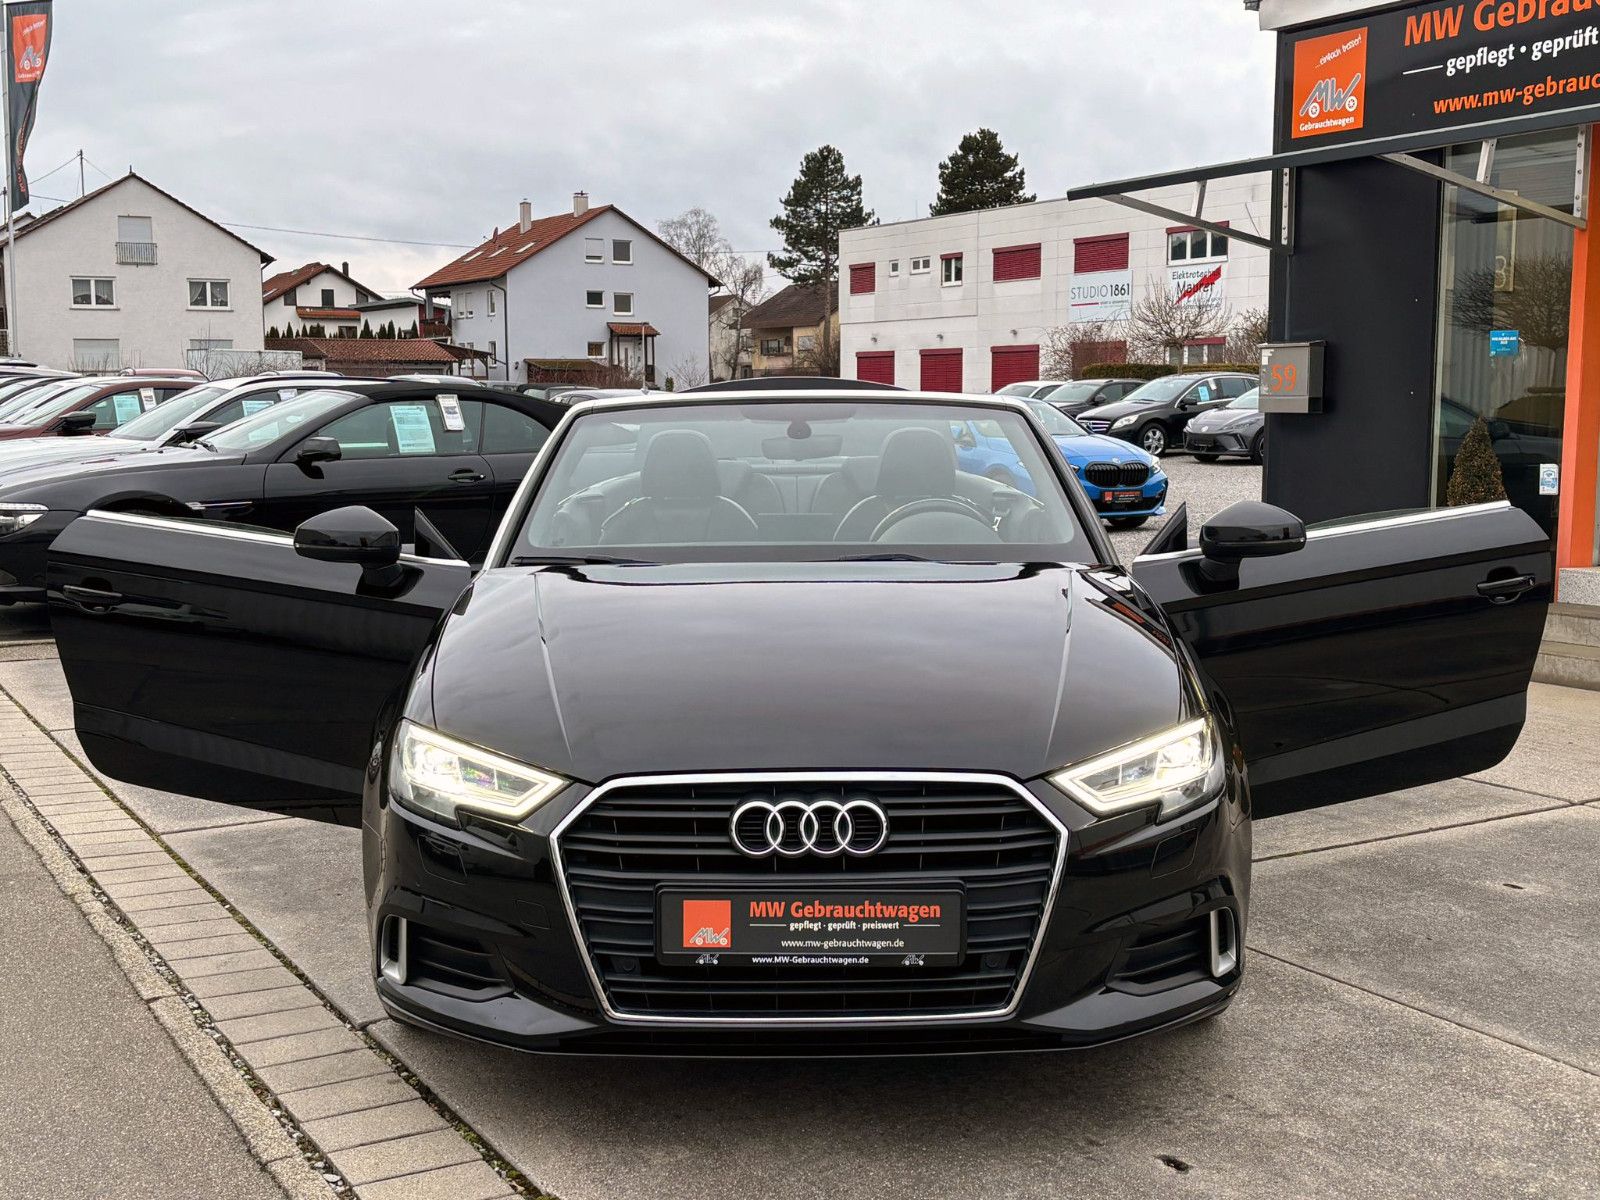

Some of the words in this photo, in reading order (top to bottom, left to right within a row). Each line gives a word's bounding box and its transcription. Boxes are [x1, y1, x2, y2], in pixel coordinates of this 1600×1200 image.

[1404, 4, 1464, 47] MW
[1446, 43, 1515, 77] gepflegt
[1531, 25, 1599, 61] geprüft
[1299, 116, 1355, 132] Gebrauchtwagen
[1271, 363, 1297, 392] 59
[749, 901, 786, 918] MW
[790, 899, 941, 923] Gebrauchtwagen
[789, 920, 821, 932] gepflegt
[827, 920, 857, 932] geprüft
[862, 920, 900, 932] preiswert
[781, 938, 905, 950] www.mw-gebrauchtwagen.de
[751, 956, 870, 966] www.MW-Gebrauchtwagen.de
